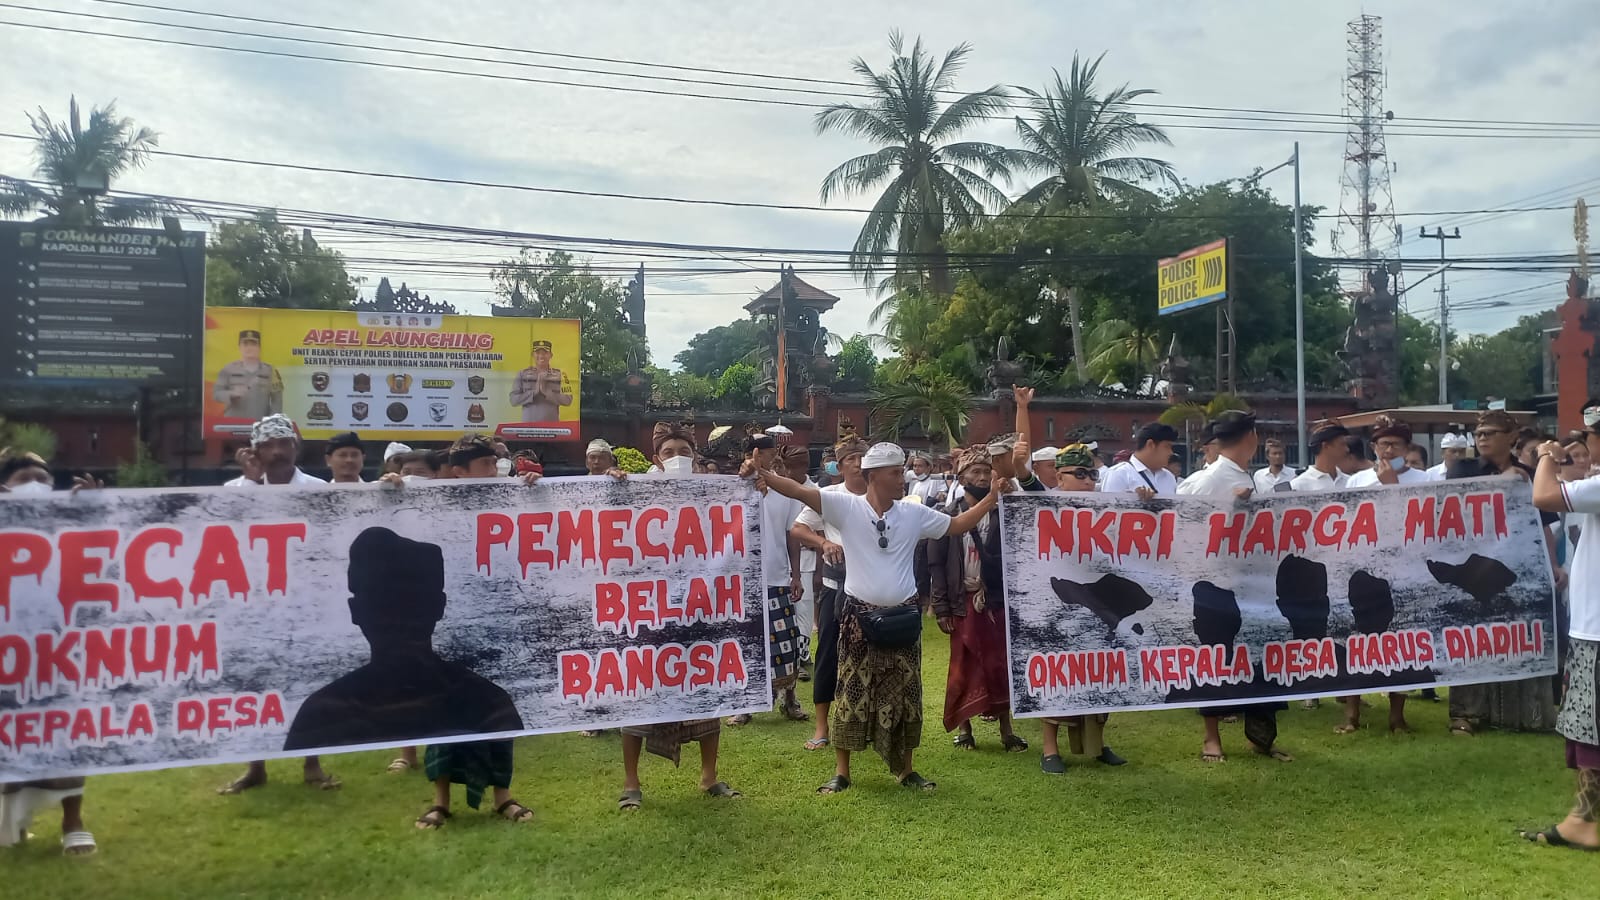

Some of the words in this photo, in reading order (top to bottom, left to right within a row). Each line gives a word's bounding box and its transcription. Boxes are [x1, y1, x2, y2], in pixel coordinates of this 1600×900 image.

[41, 243, 96, 253] KAPOLDA
[100, 245, 124, 254] BALI
[128, 246, 157, 255] 2024
[43, 230, 151, 246] COMMANDER
[1160, 280, 1198, 307] POLICE
[1161, 258, 1196, 286] POLISI
[292, 348, 309, 356] UNIT
[311, 349, 338, 357] REAKSI
[340, 349, 361, 357] CEPAT
[364, 350, 391, 358] POLRES
[393, 351, 428, 359] BULELENG
[473, 353, 503, 361] JAJARAN
[303, 328, 362, 347] APEL
[366, 330, 494, 350] LAUNCHING
[329, 358, 376, 366] PENYERAHAN
[377, 359, 418, 367] DUKUNGAN
[419, 360, 448, 368] SARANA
[450, 361, 492, 369] PRASARANA
[476, 505, 745, 580] PEMECAH
[1037, 509, 1176, 565] NKRI
[1206, 502, 1378, 560] HARGA
[1404, 493, 1508, 547] MATI
[0, 522, 307, 626] PECAT
[595, 575, 743, 635] BELAH
[0, 622, 220, 699] OKNUM
[561, 641, 745, 703] BANGSA
[1028, 651, 1127, 696] OKNUM
[1141, 646, 1251, 693] KEPALA
[1266, 639, 1336, 684] DESA
[1349, 631, 1433, 671] HARUS
[1445, 623, 1542, 665] DIADILI
[178, 693, 284, 738] DESA
